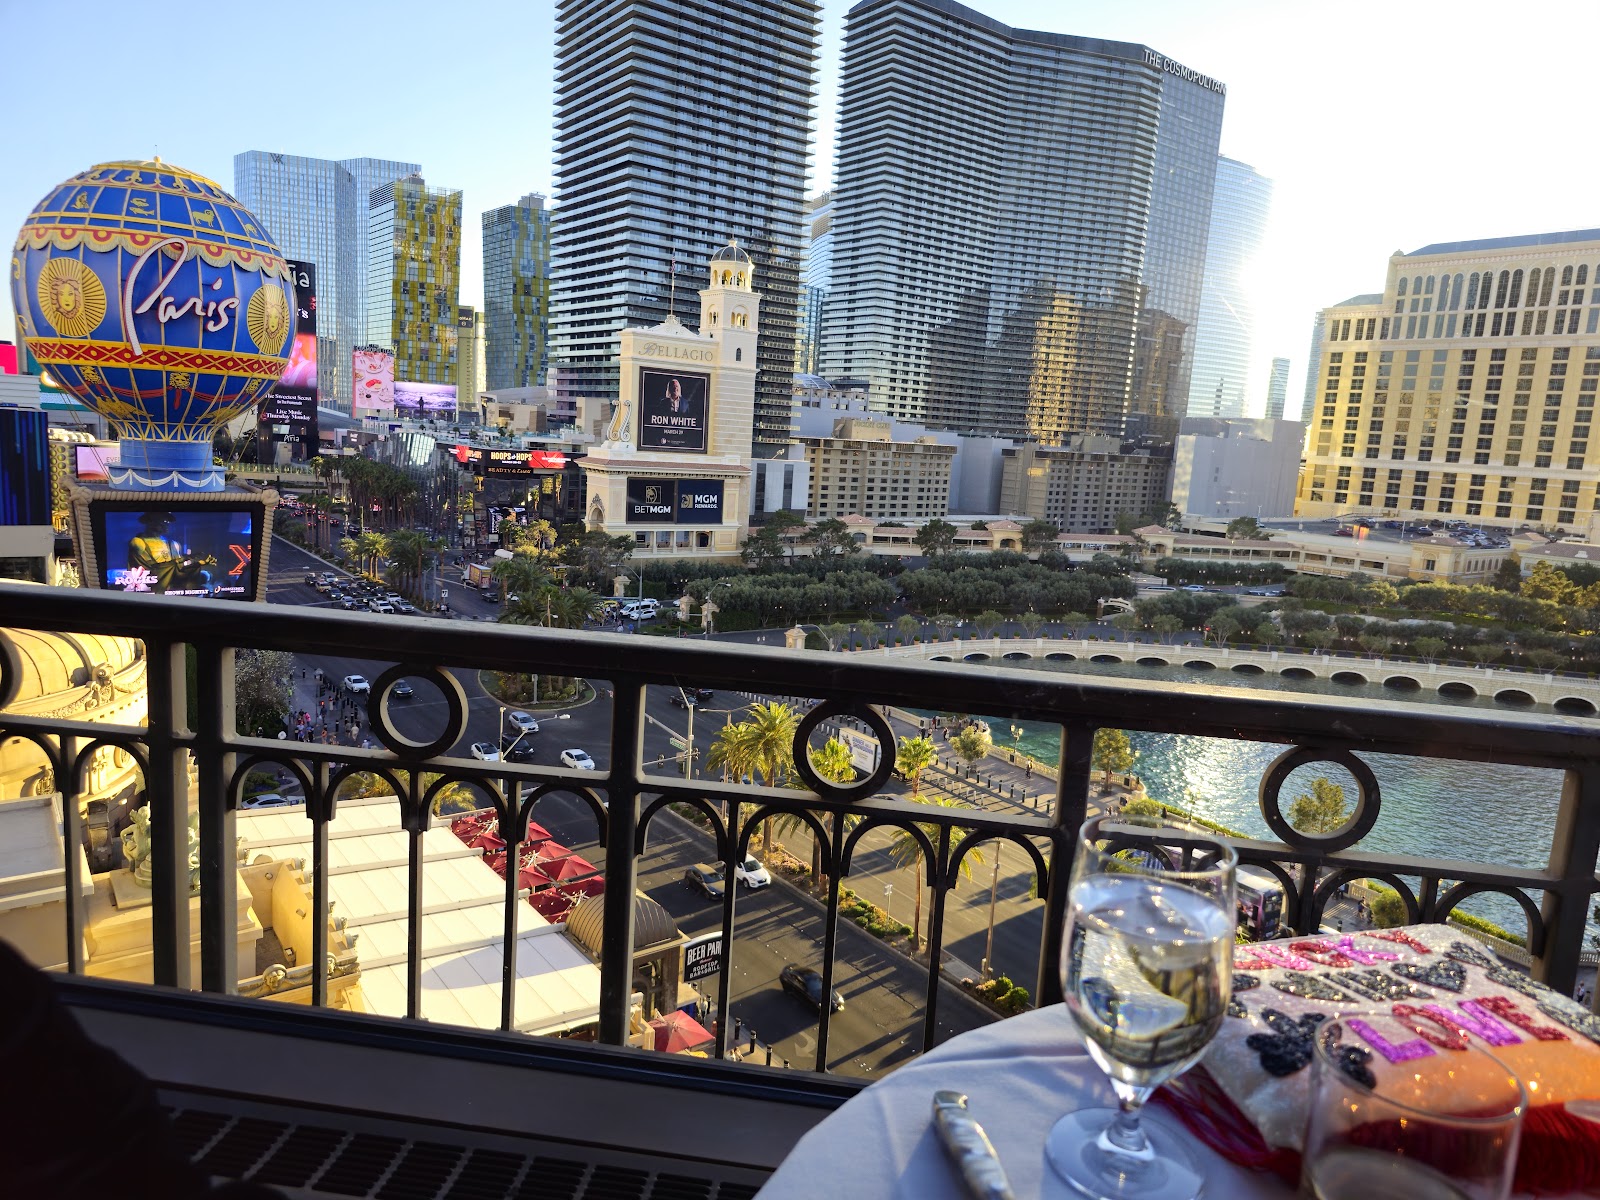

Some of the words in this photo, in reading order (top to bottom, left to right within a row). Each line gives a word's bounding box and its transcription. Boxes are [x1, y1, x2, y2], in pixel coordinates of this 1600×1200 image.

[1144, 49, 1162, 68] THE
[1163, 58, 1226, 95] COSMOPOLITAN
[122, 237, 240, 356] Paris
[638, 341, 714, 362] BELLAGIO
[266, 412, 291, 420] Thursday
[651, 415, 669, 424] RON
[670, 416, 697, 427] WHITE
[284, 434, 300, 442] Aria
[490, 451, 512, 460] HOOPS
[516, 453, 533, 461] HOPS
[695, 494, 718, 504] MGM
[634, 505, 671, 514] BETMGM
[687, 944, 706, 966] BEER
[693, 960, 718, 973] ROOFTOP
[1346, 996, 1571, 1065] LOVE
